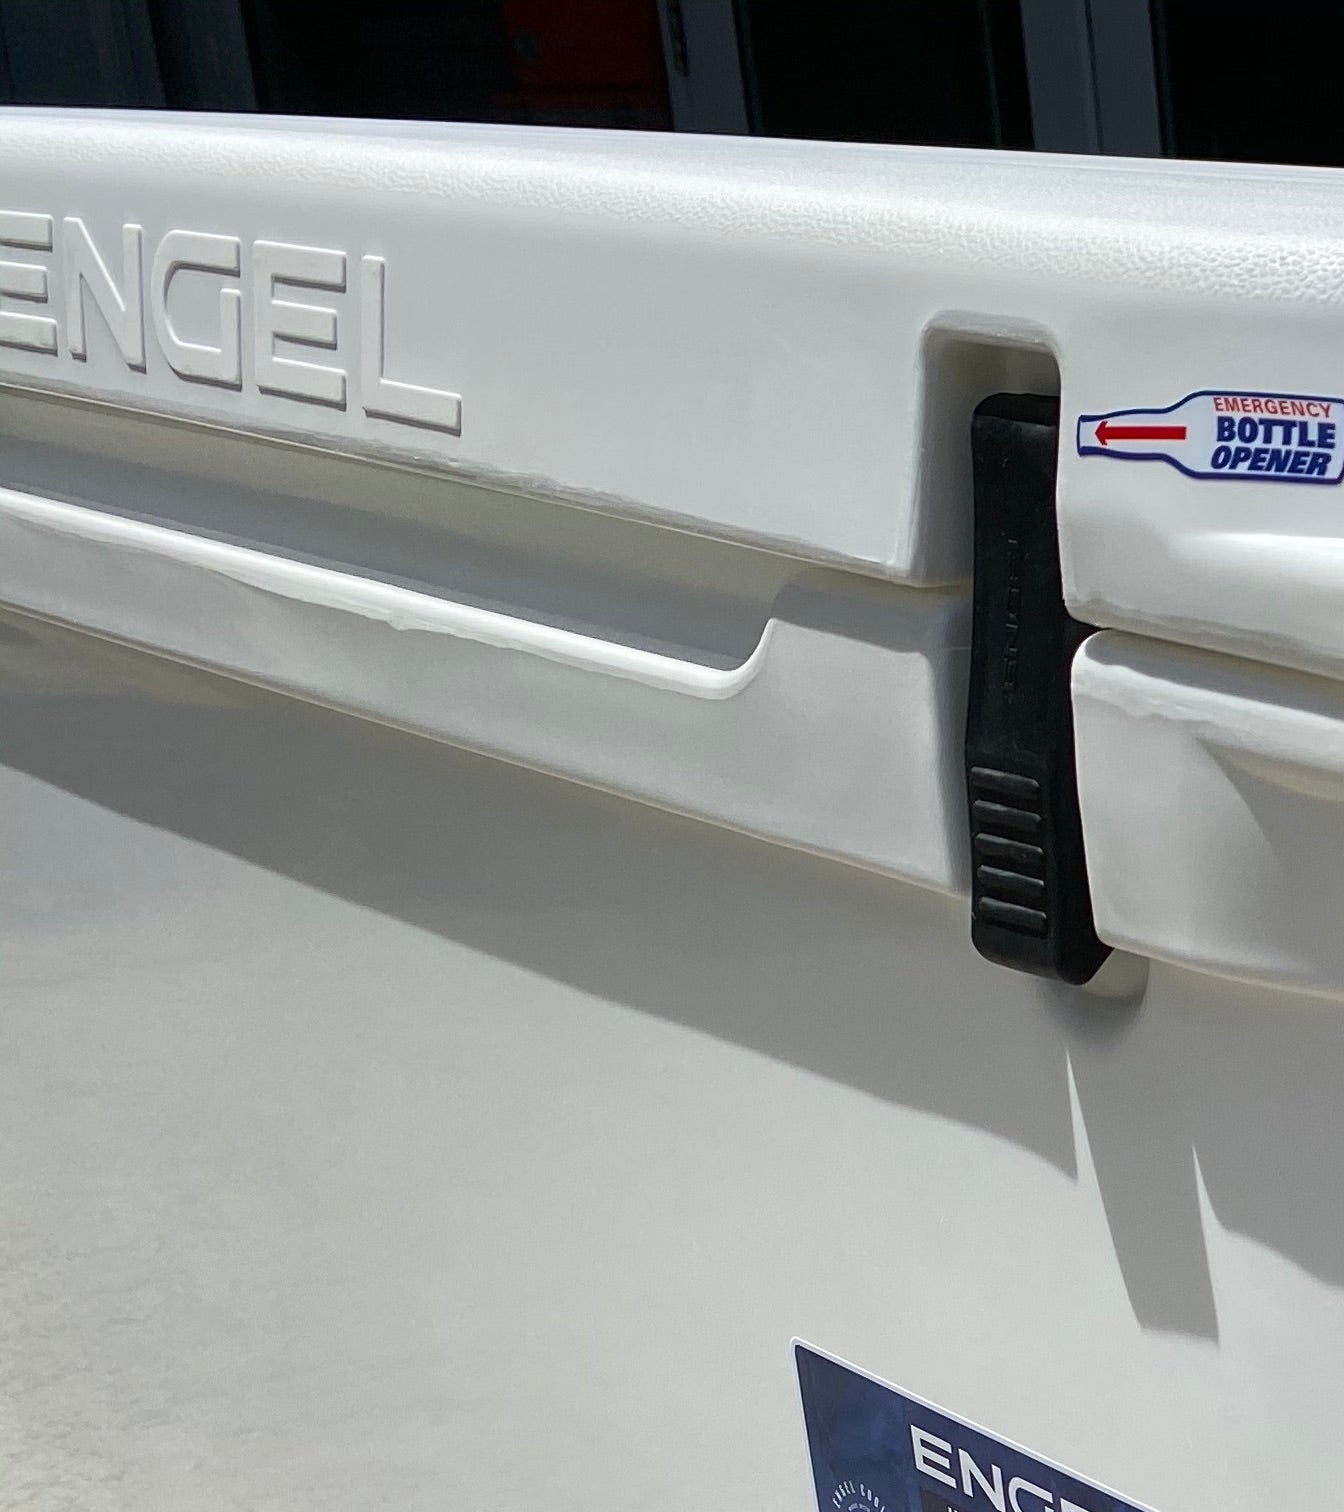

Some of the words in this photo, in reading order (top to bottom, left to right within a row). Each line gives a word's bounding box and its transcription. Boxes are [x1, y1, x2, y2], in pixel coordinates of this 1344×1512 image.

[1213, 397, 1331, 418] EMERGENCY
[1216, 416, 1336, 449] BOTTLE
[1210, 445, 1332, 476] OPENER
